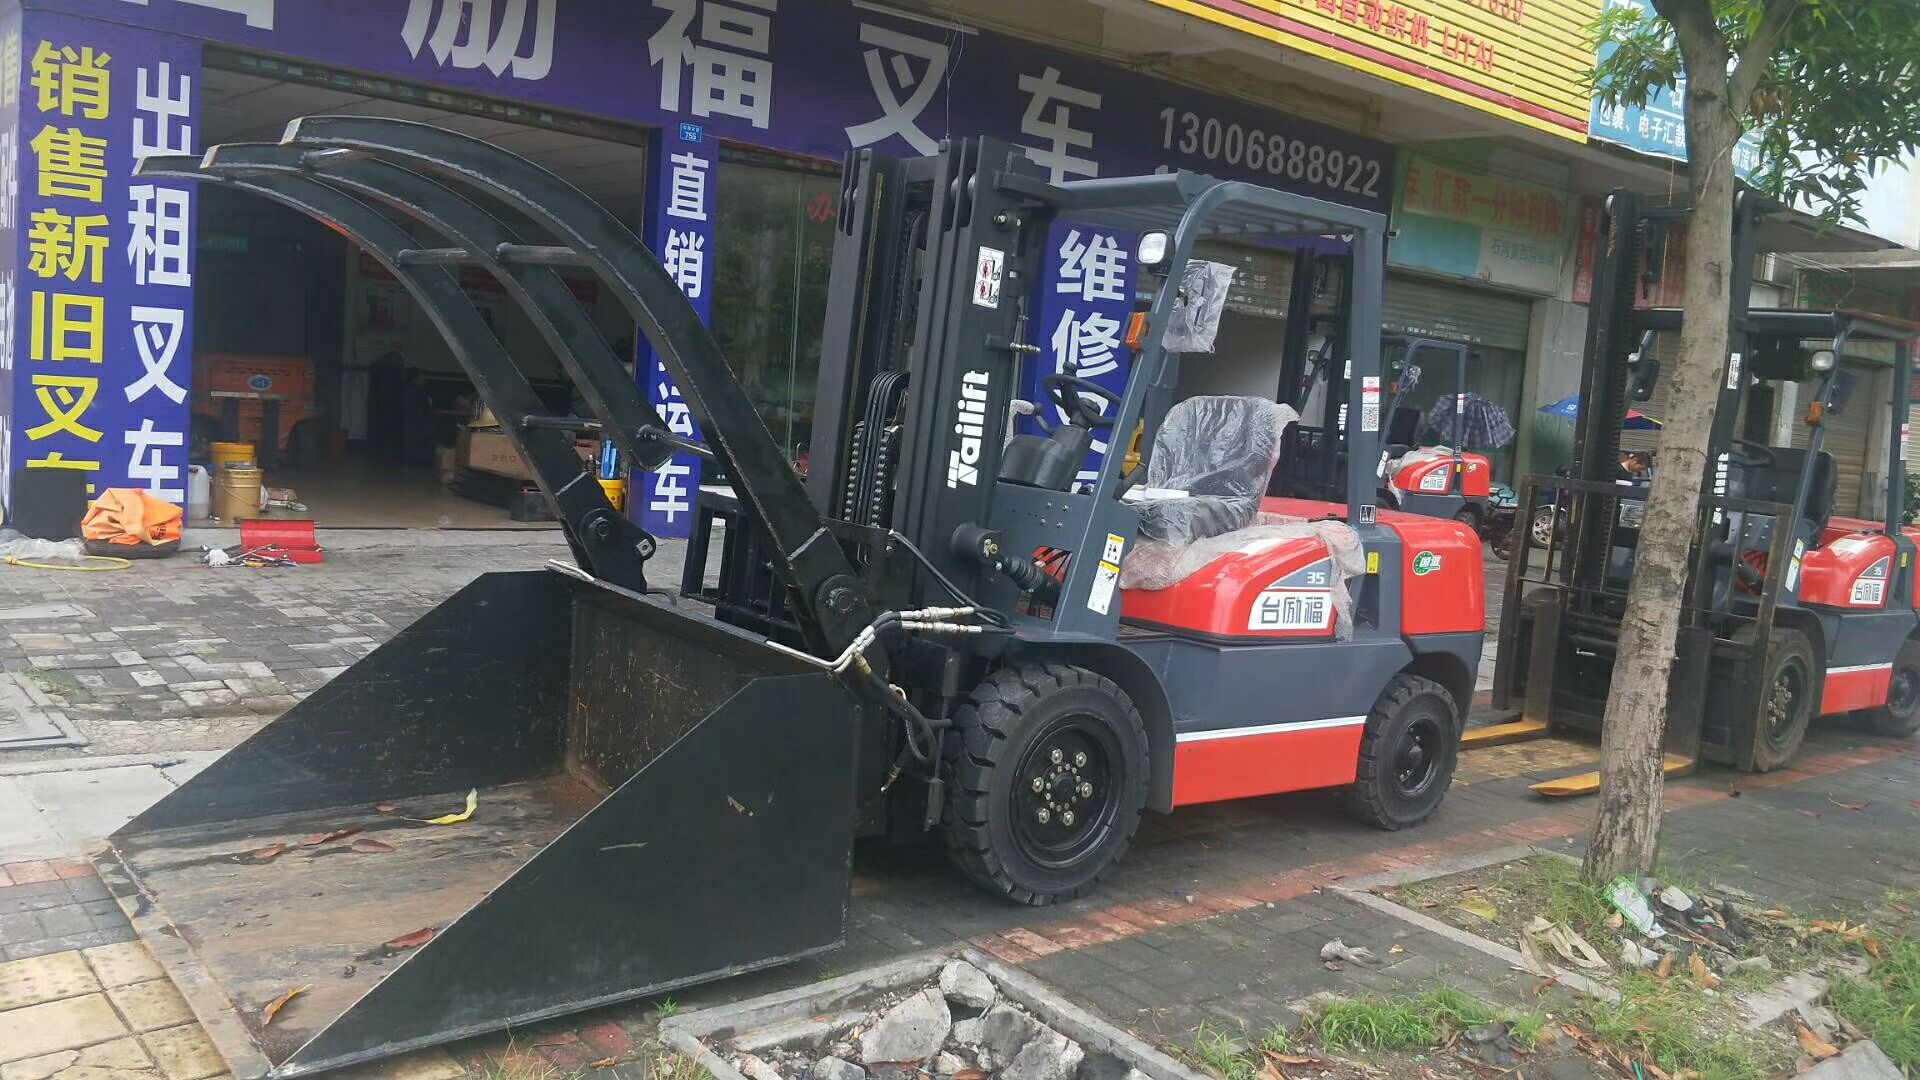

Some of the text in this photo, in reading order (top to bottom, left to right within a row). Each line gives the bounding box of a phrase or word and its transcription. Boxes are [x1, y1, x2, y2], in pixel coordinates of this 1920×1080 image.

[1442, 25, 1494, 72] LITAI
[1160, 107, 1381, 198] 13006888922
[124, 62, 191, 502] 出租叉车
[650, 152, 709, 523] 直销运车
[947, 371, 989, 489] Tailift
[1261, 596, 1324, 624] 台励福
[1306, 571, 1326, 585] 35
